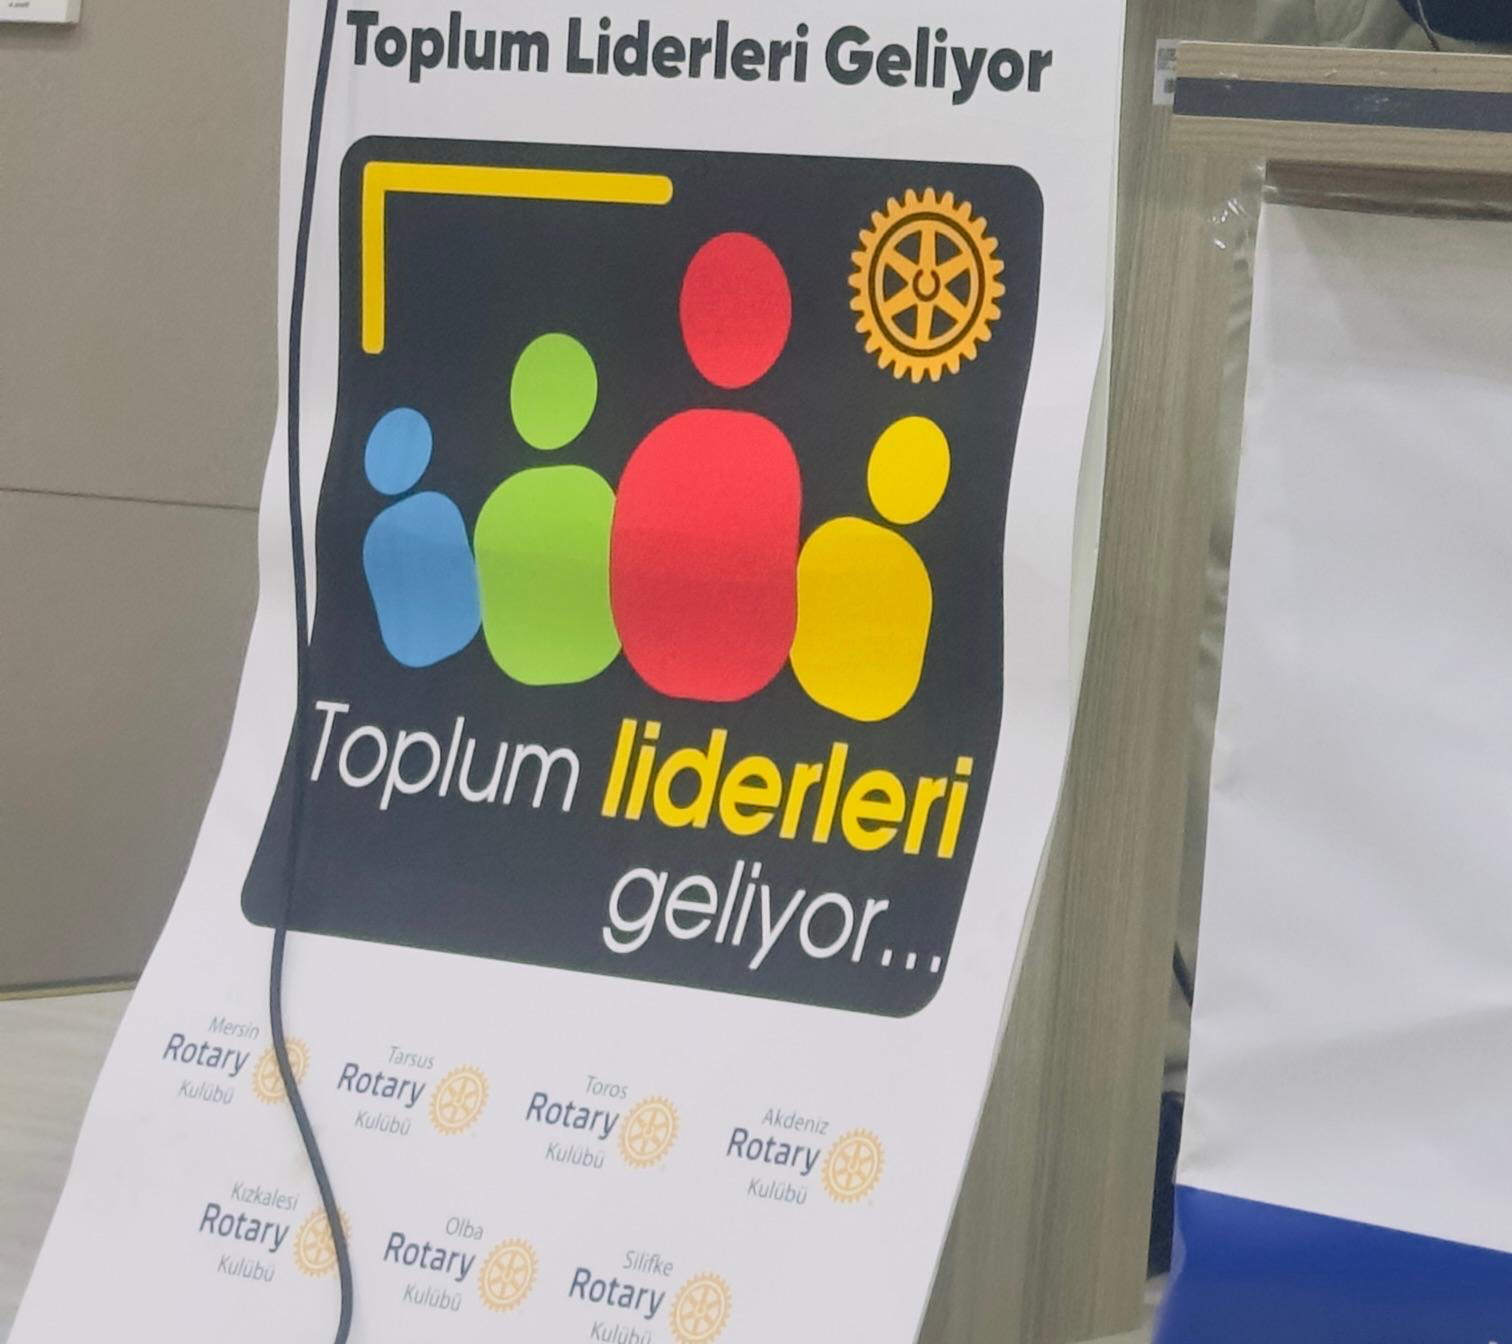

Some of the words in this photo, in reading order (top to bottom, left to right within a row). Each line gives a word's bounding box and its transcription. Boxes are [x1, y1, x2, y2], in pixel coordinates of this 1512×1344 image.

[346, 9, 549, 83] Toplum
[566, 17, 808, 82] Liderleri
[825, 26, 1052, 105] Geliyor
[310, 701, 580, 810] Toplum
[601, 718, 974, 858] liderleri
[602, 860, 943, 972] geliyor...
[207, 1015, 260, 1040] Mersin
[162, 1032, 250, 1078] Rotary
[388, 1046, 435, 1070] Tarsus
[178, 1079, 235, 1105] Kulübü
[336, 1062, 426, 1109] Rotary
[585, 1075, 629, 1099] Toros
[354, 1109, 412, 1136] Kulübü
[525, 1091, 620, 1141] Rotary
[761, 1108, 830, 1135] Akdeniz
[545, 1141, 605, 1169] Kulübü
[726, 1127, 821, 1176] Rotary
[230, 1181, 299, 1212] Kızkalesi
[747, 1177, 808, 1205] Kulübü
[199, 1202, 290, 1253] Rotary
[445, 1216, 484, 1241] Olba
[217, 1254, 276, 1283] Kulübü
[383, 1231, 476, 1283] Rotary
[622, 1249, 675, 1277] Silifke
[402, 1283, 463, 1312] Kulübü
[568, 1267, 666, 1320] Rotary
